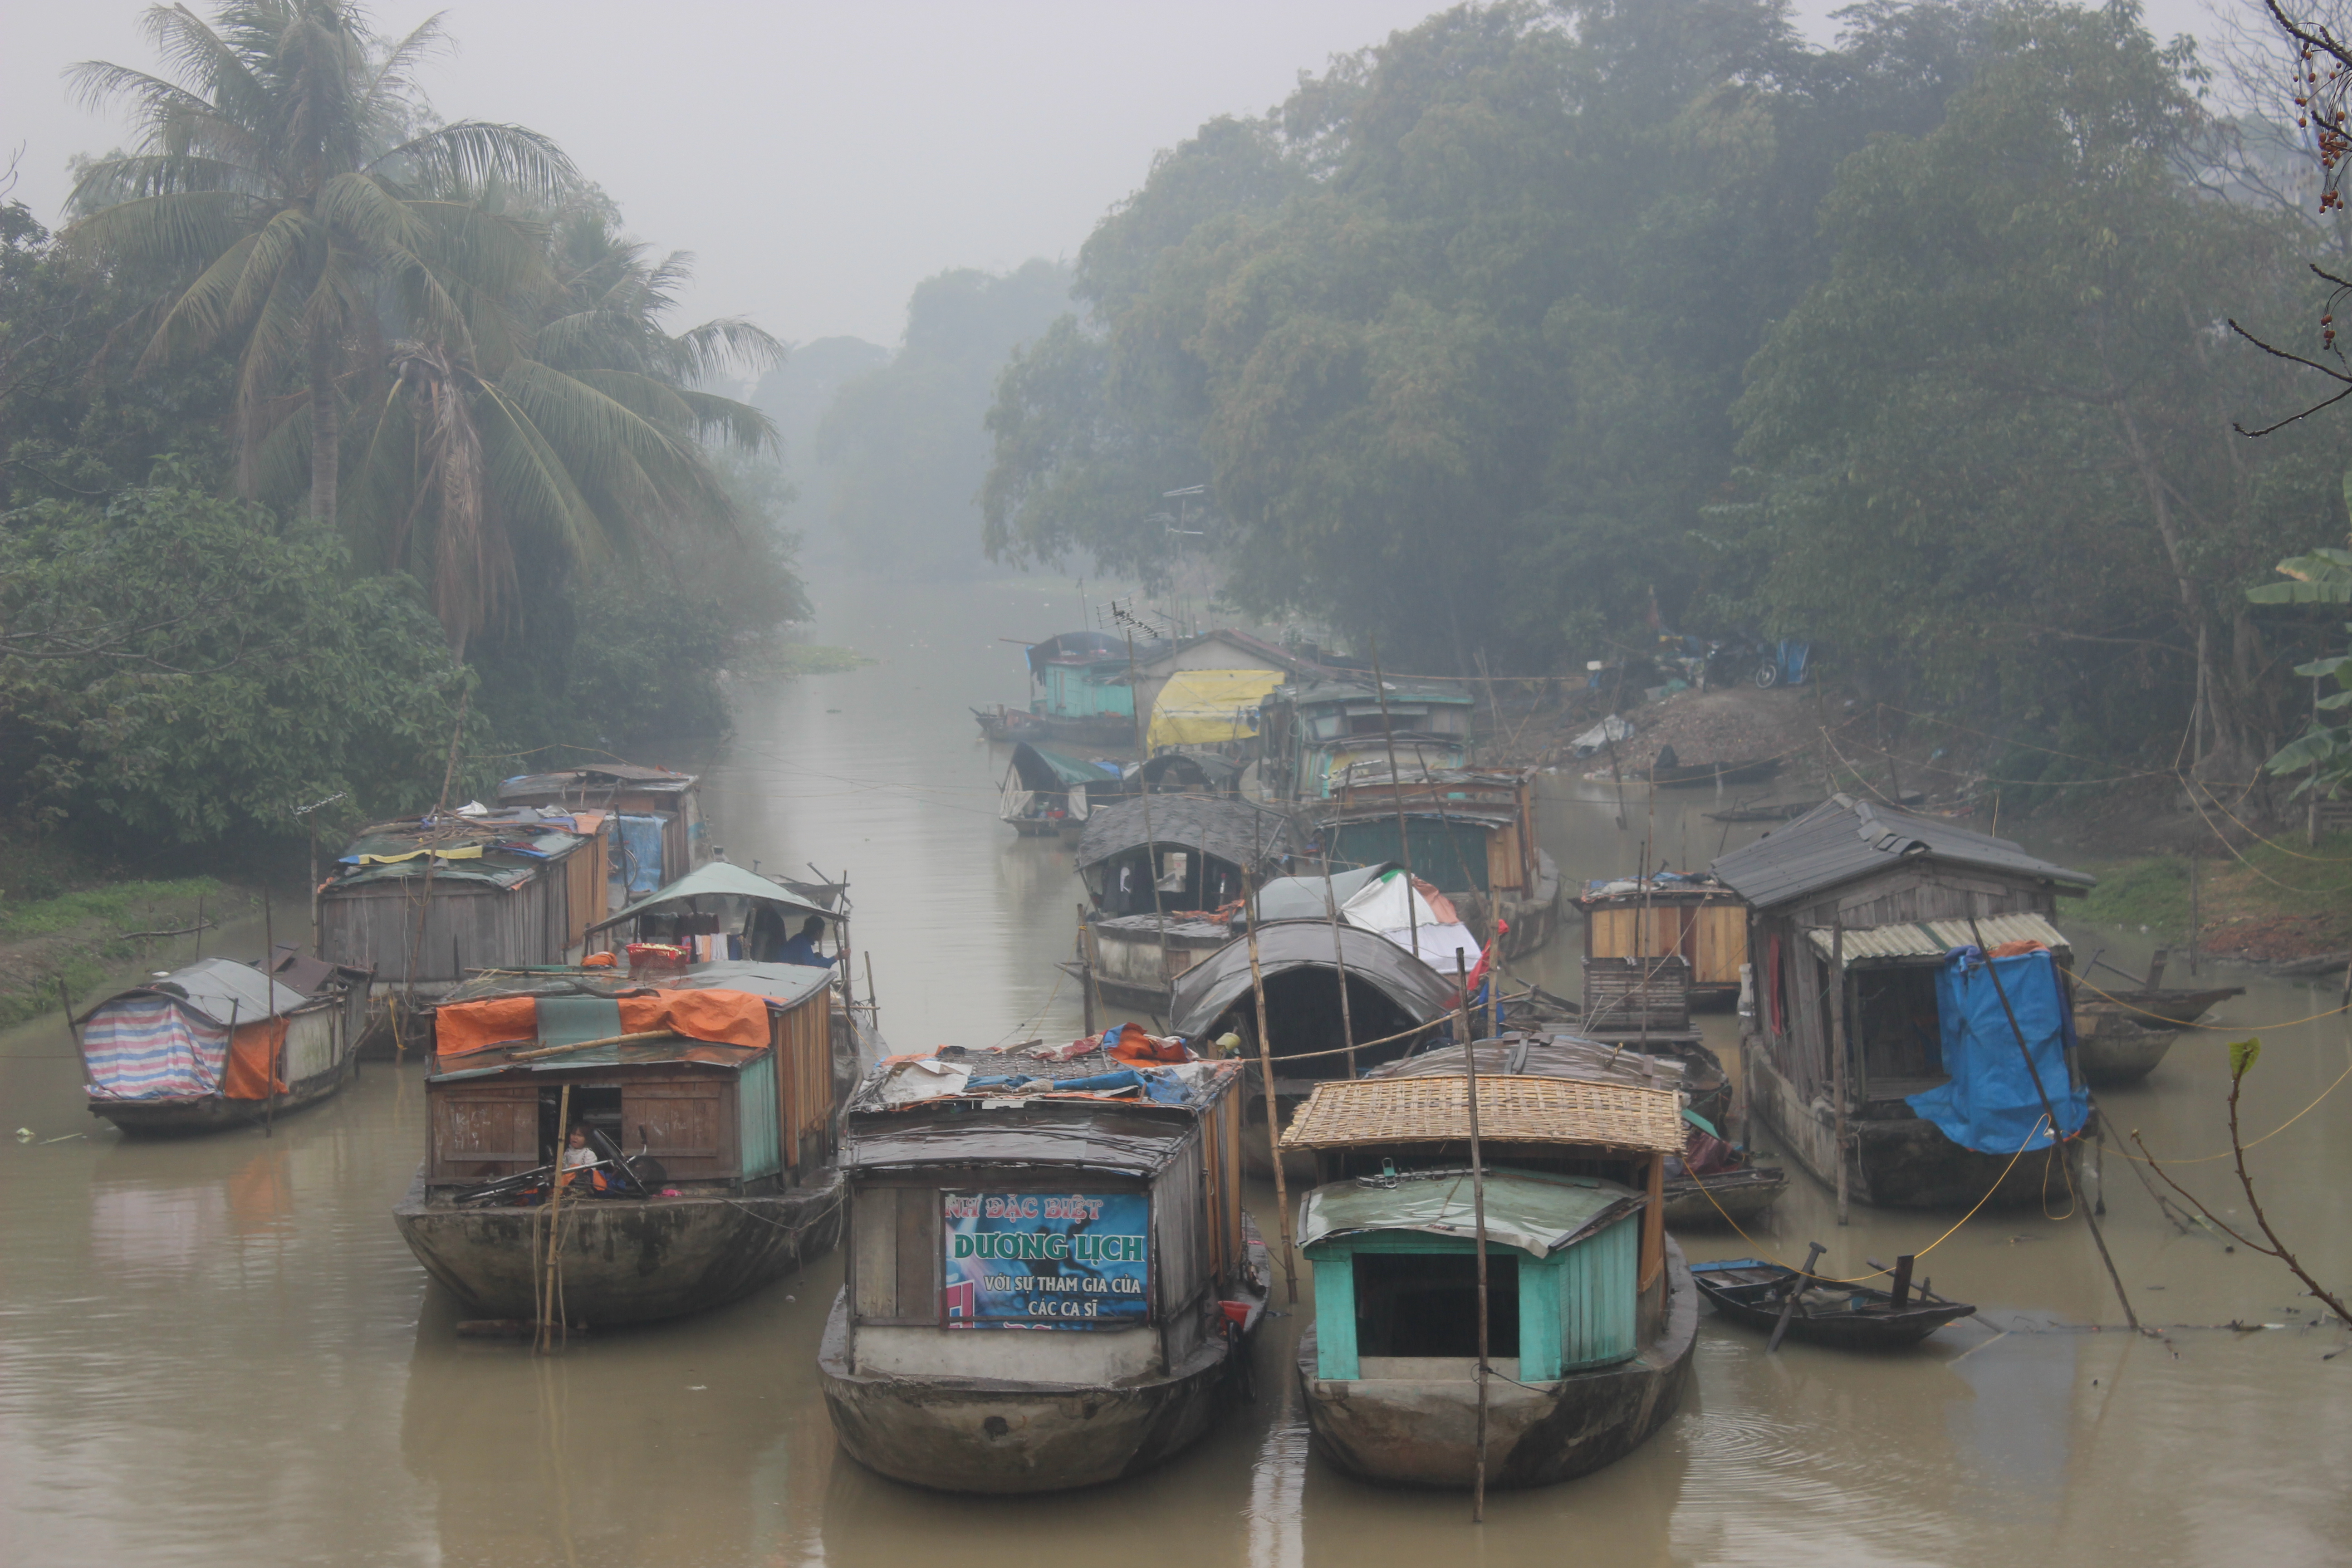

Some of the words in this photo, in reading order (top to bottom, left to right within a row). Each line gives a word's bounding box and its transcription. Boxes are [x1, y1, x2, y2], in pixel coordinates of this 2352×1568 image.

[985, 1194, 1038, 1223] ĐẶC
[1044, 1194, 1103, 1224] BIỆT
[954, 1231, 1068, 1260] DƯƠNG
[1073, 1234, 1145, 1266] LỊCH
[984, 1272, 1011, 1291] VỚI
[1014, 1275, 1034, 1294] SỰ
[1037, 1276, 1078, 1292] THAM
[1082, 1277, 1107, 1293] GIA
[1112, 1274, 1141, 1294] CỦA
[1028, 1298, 1057, 1316] CÁC
[1060, 1302, 1080, 1316] CA
[1084, 1299, 1098, 1316] SĨ
